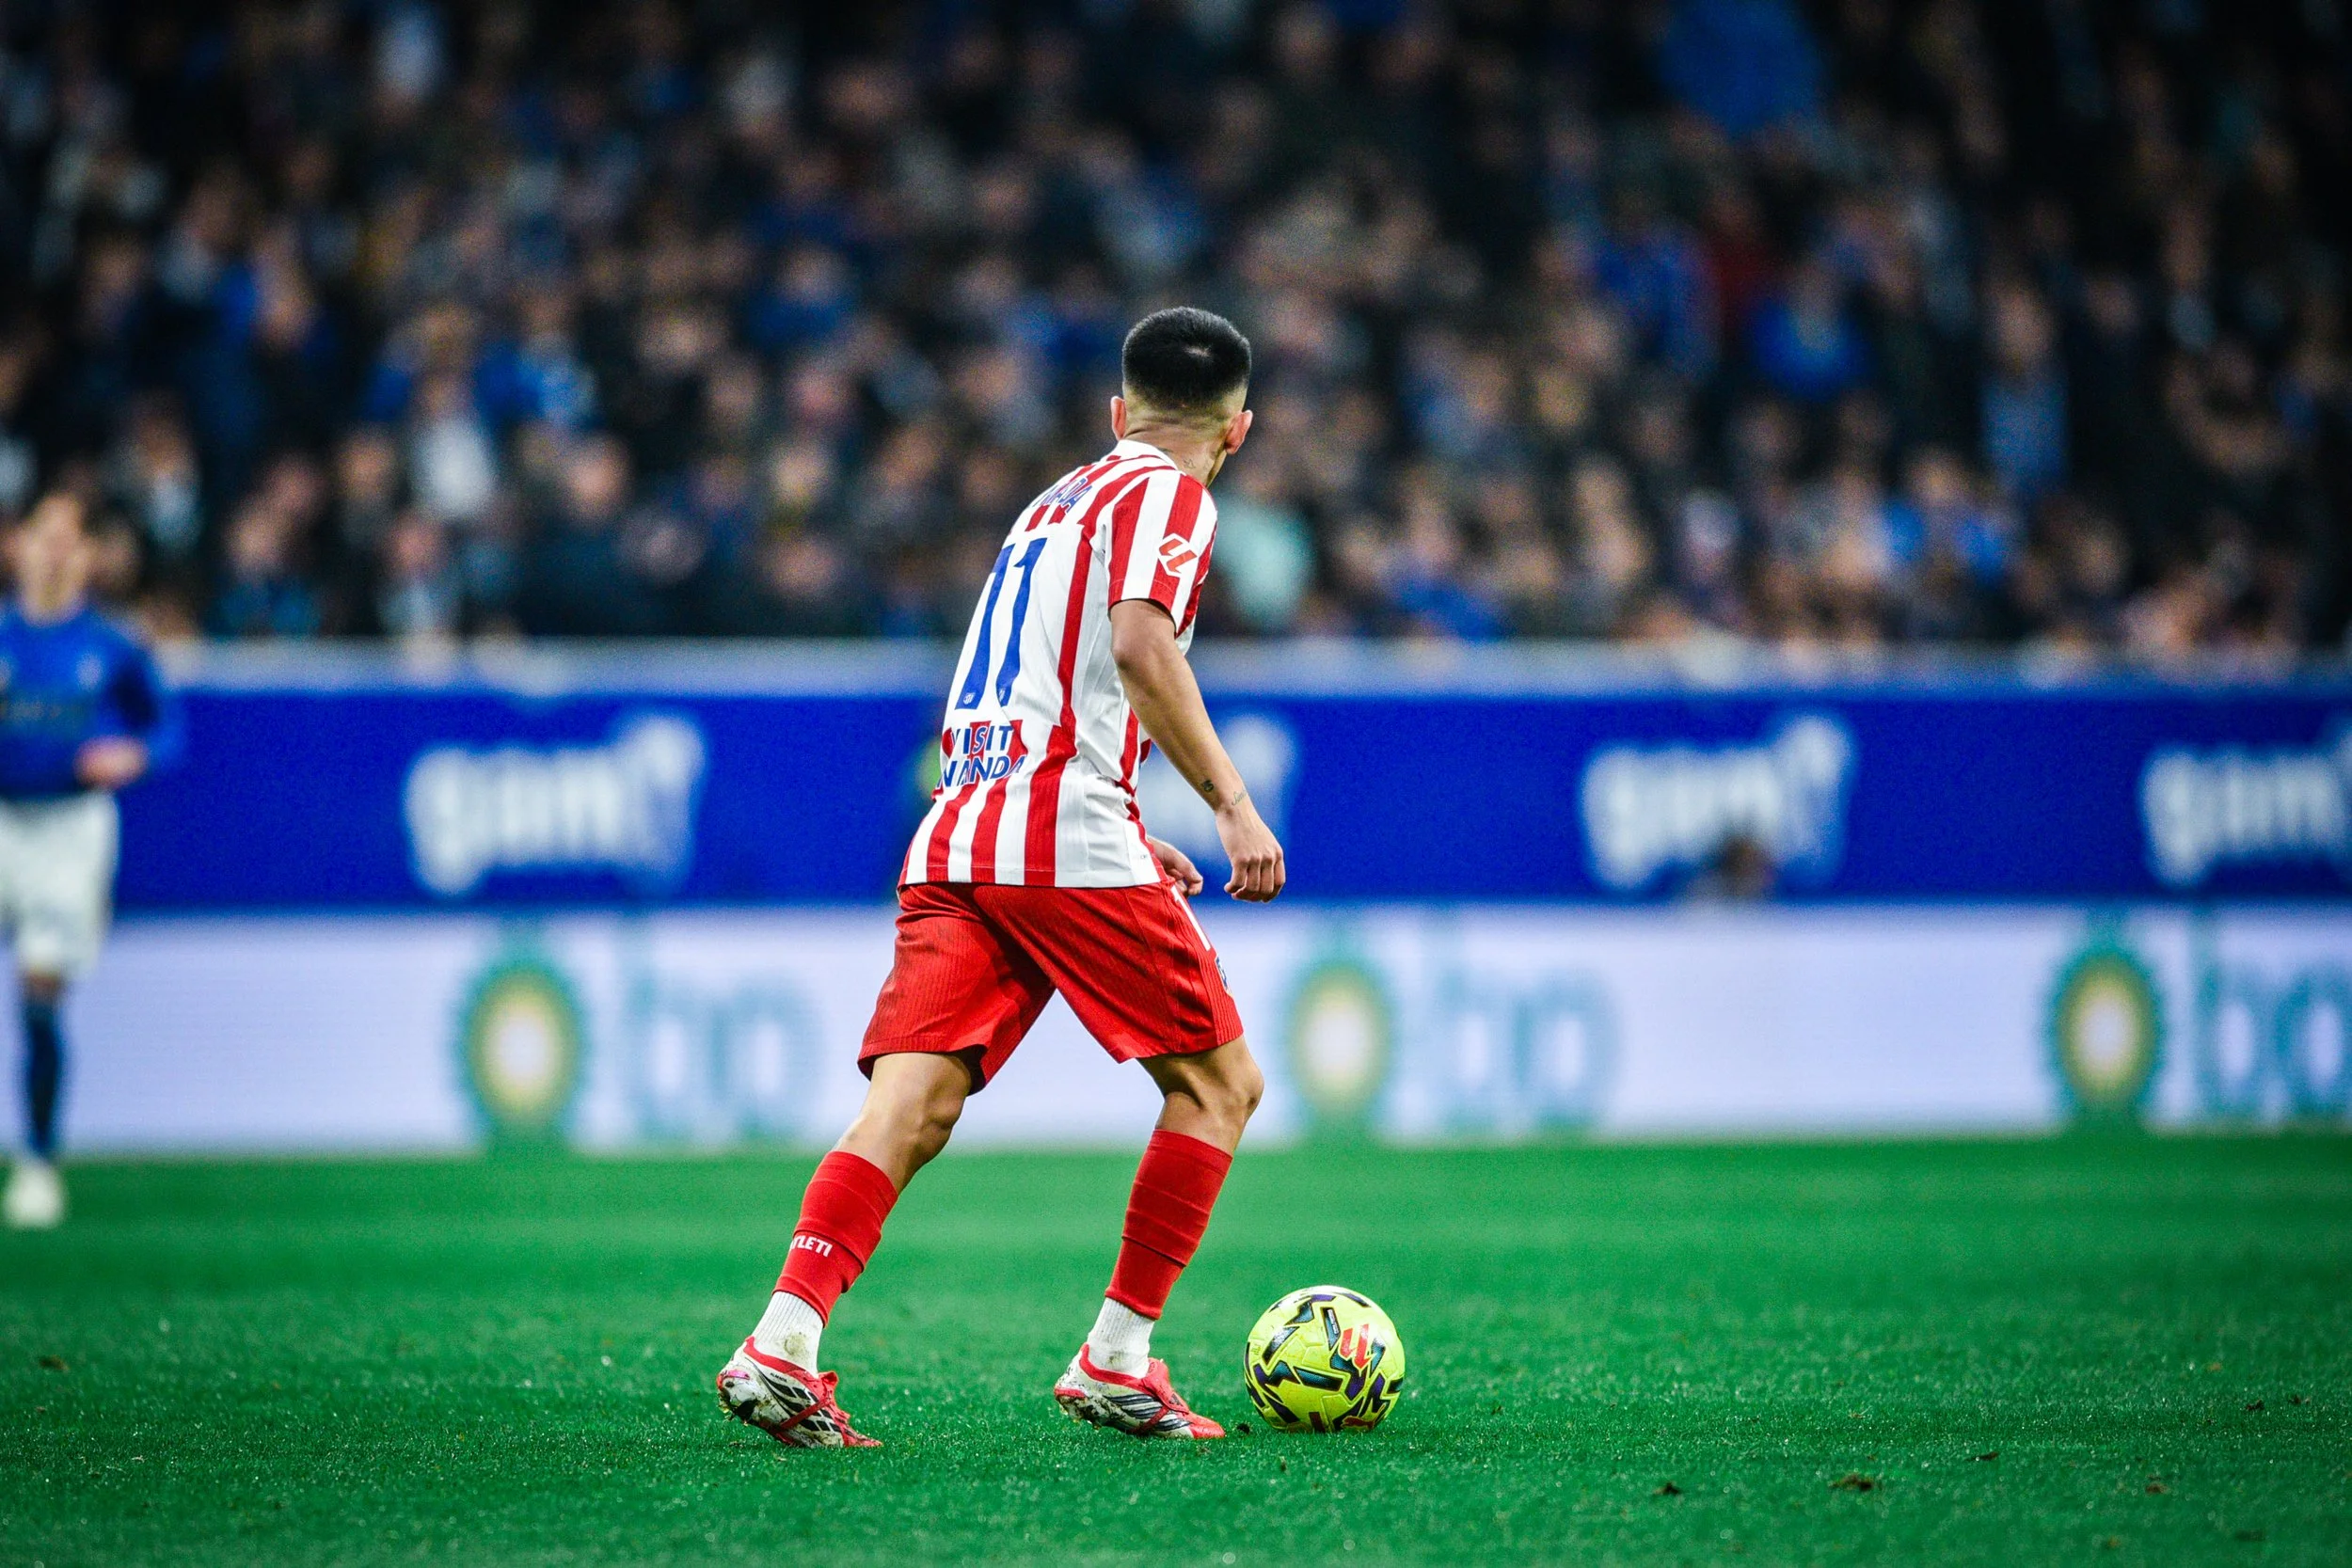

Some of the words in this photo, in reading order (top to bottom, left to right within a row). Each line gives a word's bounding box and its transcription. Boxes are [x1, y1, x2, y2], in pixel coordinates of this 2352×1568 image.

[954, 537, 1048, 710] 11
[951, 725, 1014, 754] VISIT
[789, 1235, 834, 1258] TLETI
